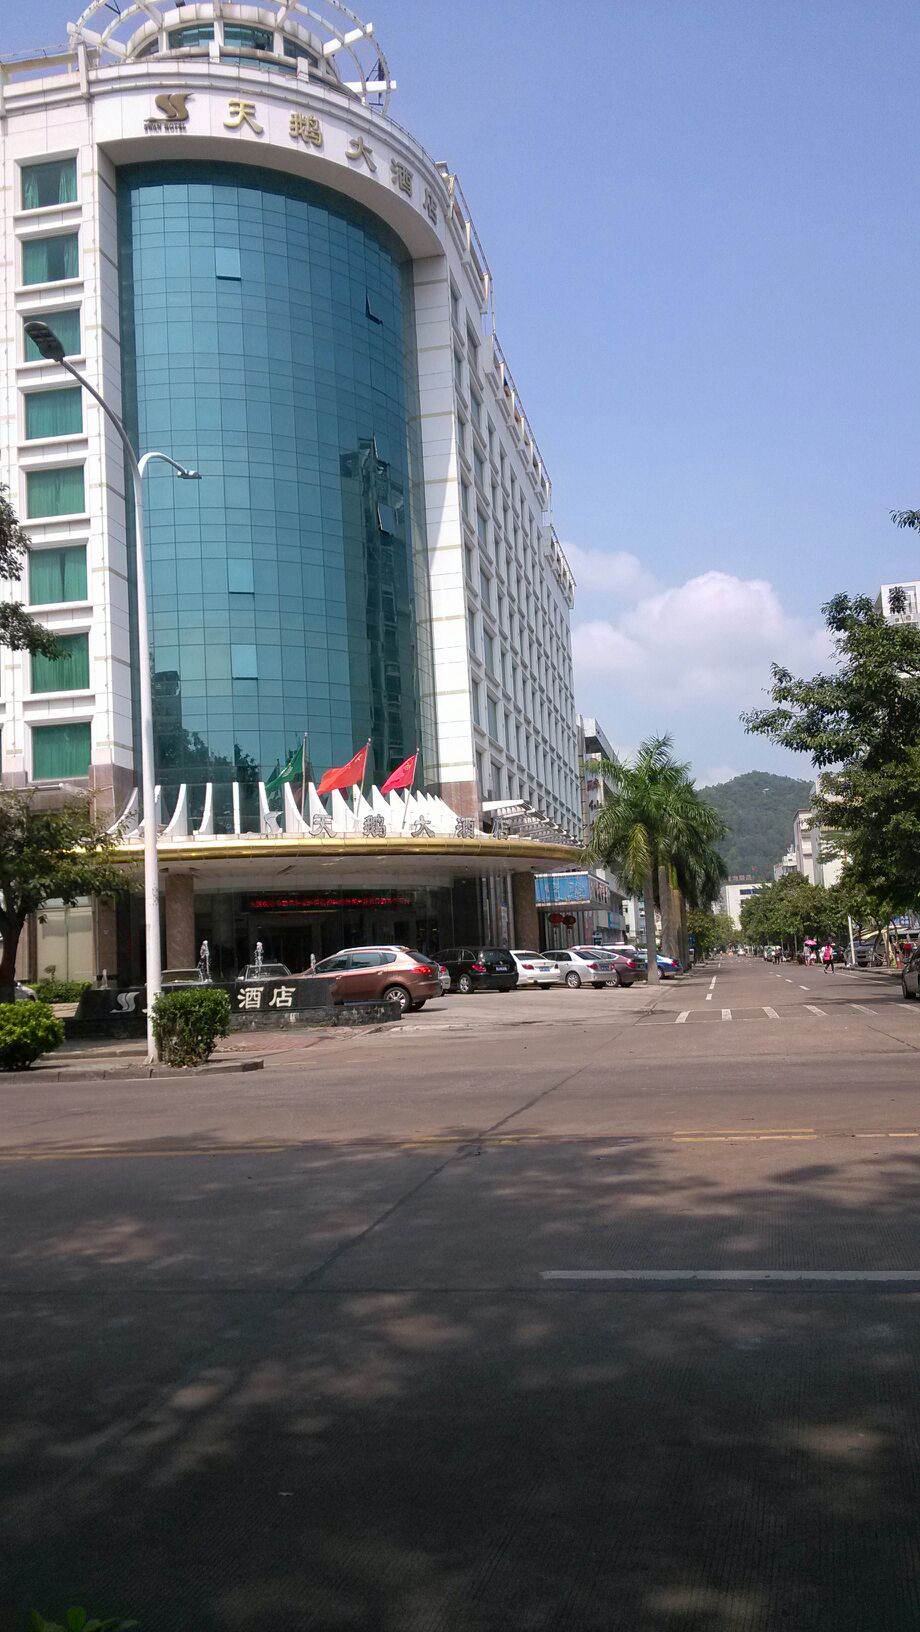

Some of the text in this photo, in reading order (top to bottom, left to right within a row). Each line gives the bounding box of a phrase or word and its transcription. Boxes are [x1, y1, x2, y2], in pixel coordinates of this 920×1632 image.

[223, 98, 437, 226] 天鹅大酒店
[237, 985, 296, 1010] 酒店
